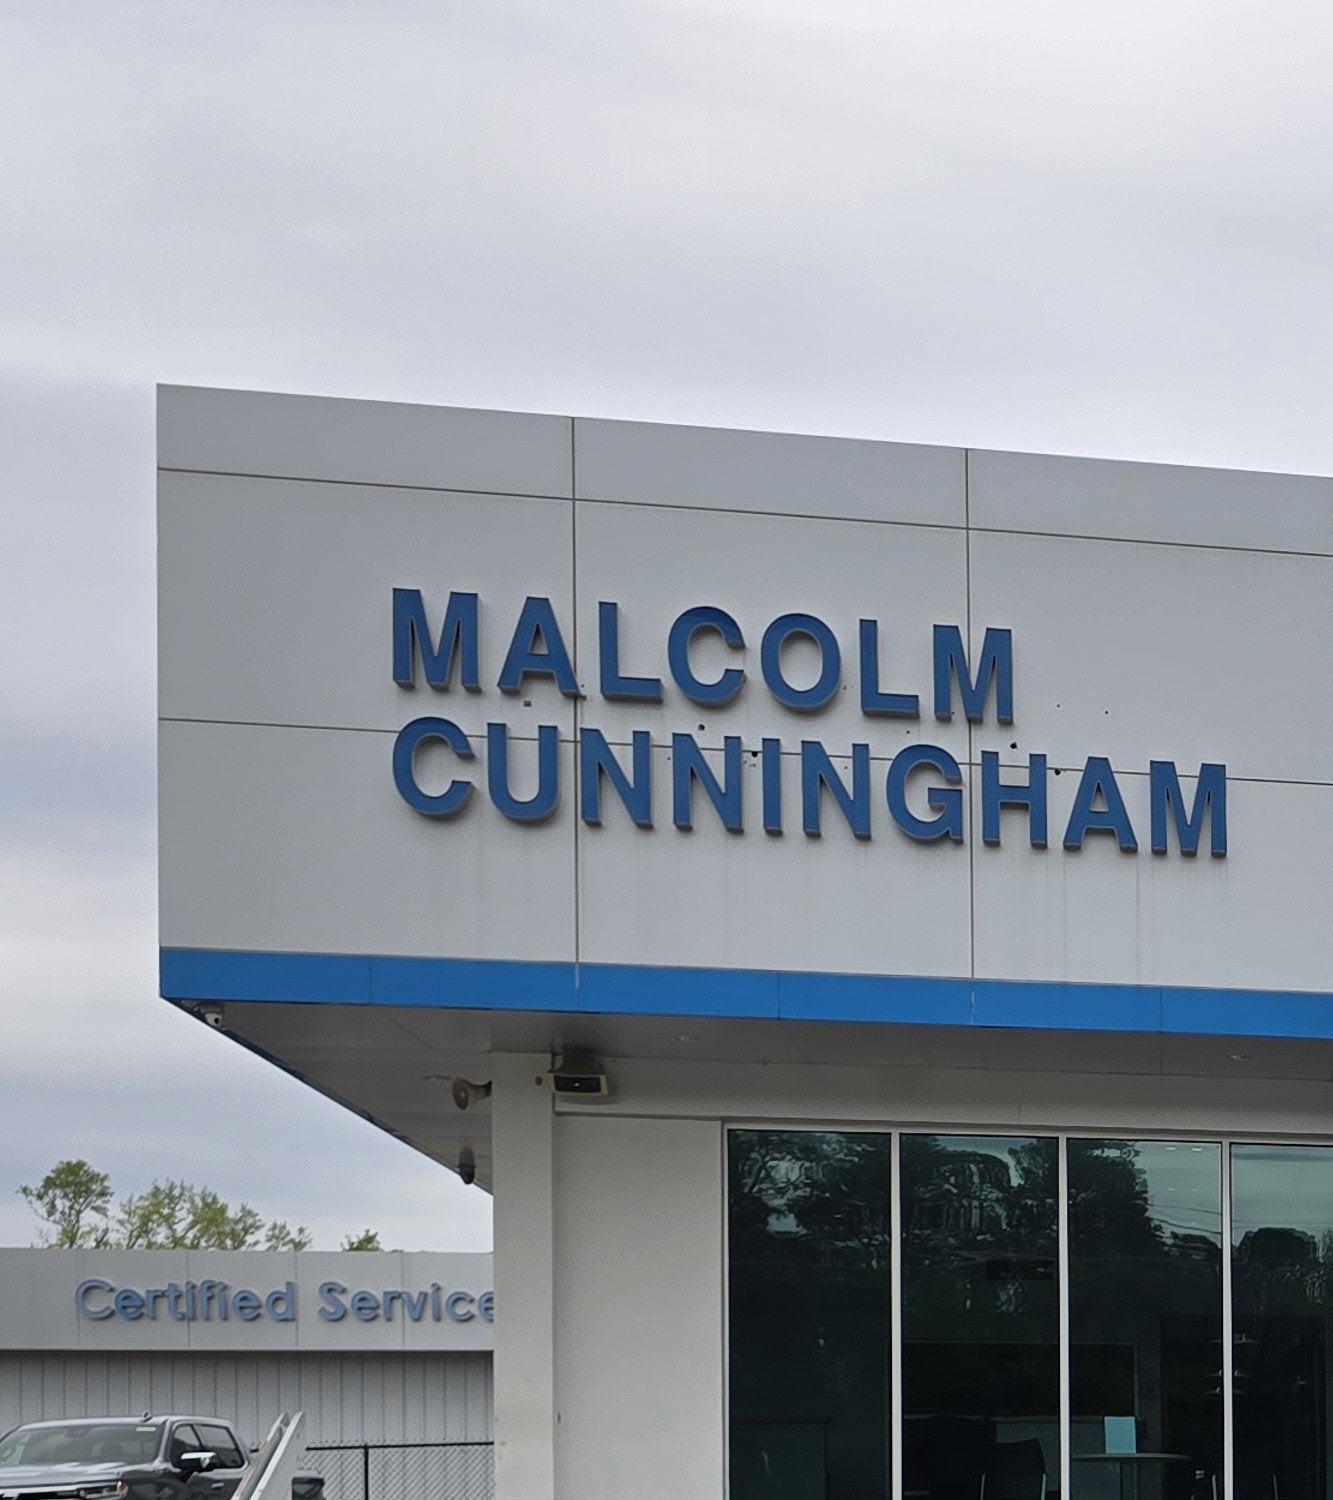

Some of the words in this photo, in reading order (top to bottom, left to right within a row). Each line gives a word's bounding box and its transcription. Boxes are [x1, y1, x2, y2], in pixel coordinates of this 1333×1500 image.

[392, 587, 1014, 726] MALCOLM
[392, 715, 1228, 858] CUNNINGHAM
[75, 1278, 296, 1323] Certified
